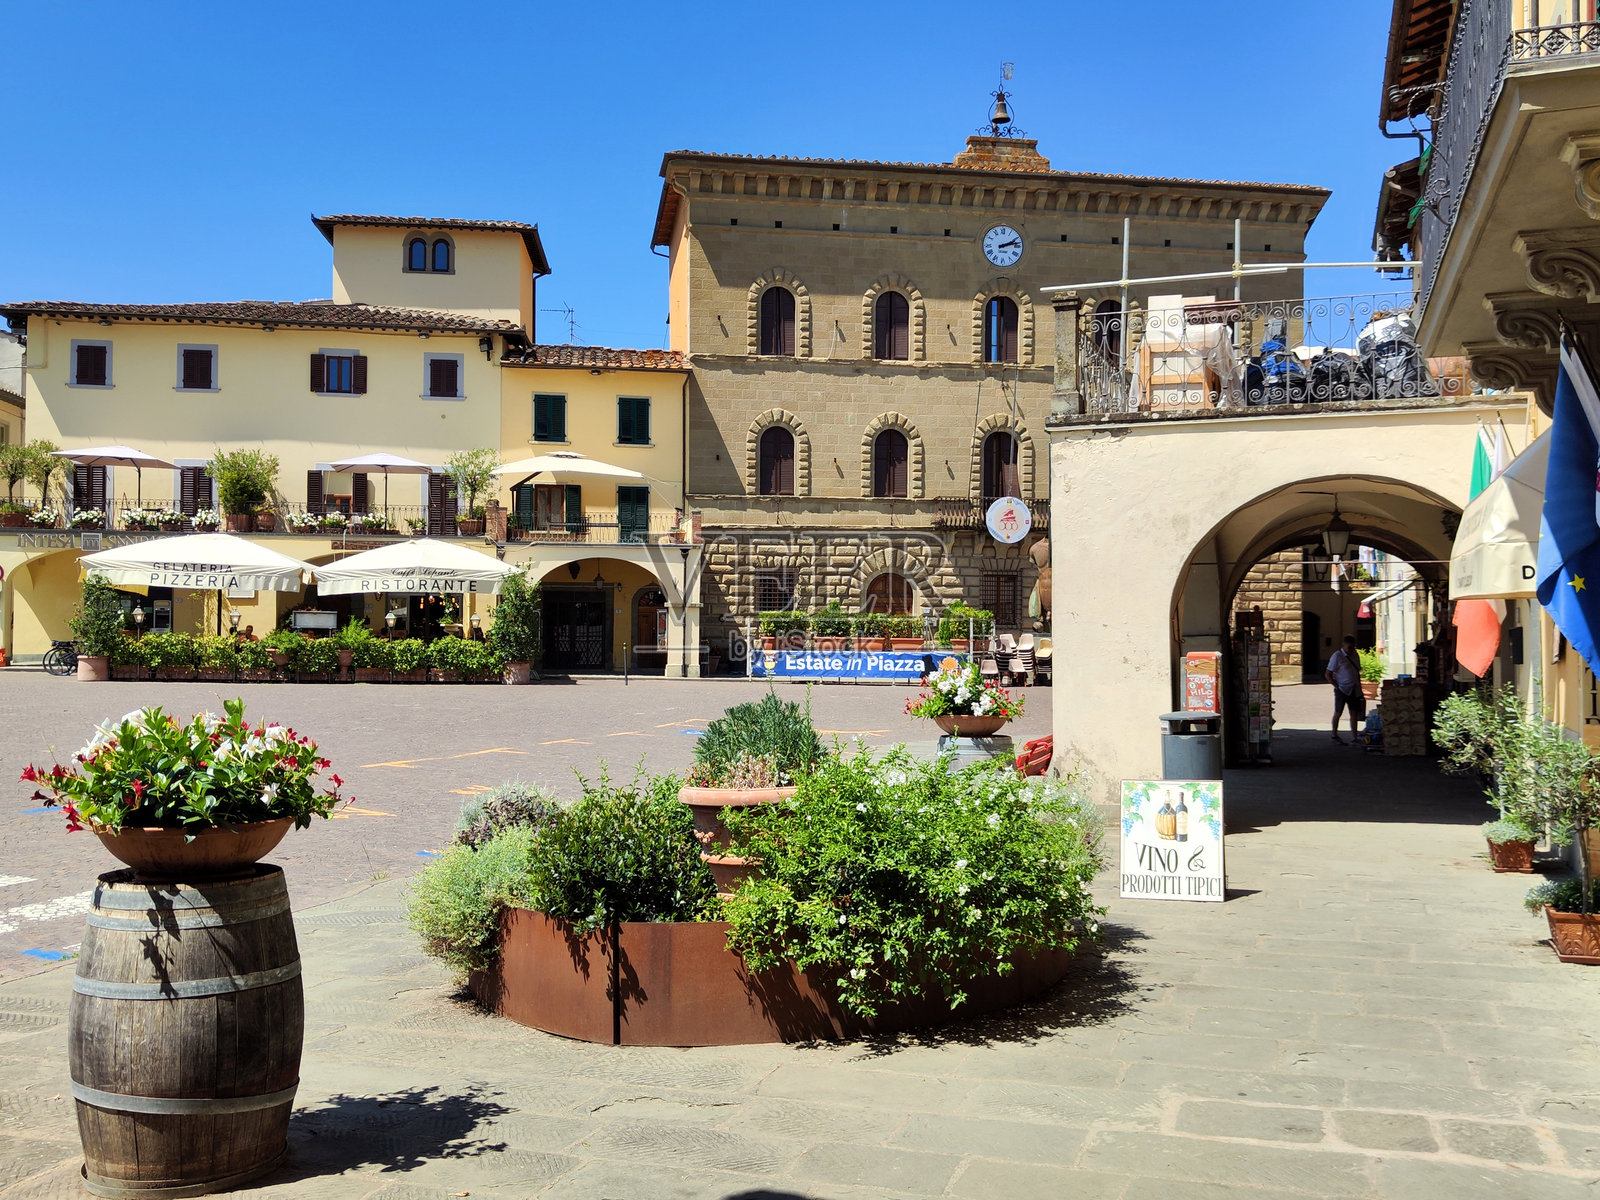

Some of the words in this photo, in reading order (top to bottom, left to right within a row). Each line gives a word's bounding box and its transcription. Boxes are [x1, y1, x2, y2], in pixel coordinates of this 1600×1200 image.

[17, 532, 75, 548] INTESA
[153, 562, 233, 573] GELATERIA
[150, 573, 239, 588] PIZZERIA
[361, 580, 478, 592] RISTORANTE
[785, 654, 843, 671] Estate
[846, 657, 862, 671] in
[866, 656, 925, 672] Piazza
[1134, 842, 1179, 873] VINO
[1187, 845, 1207, 872] &
[1122, 874, 1182, 895] PRODOTTI
[1184, 876, 1222, 897] TIPICI
